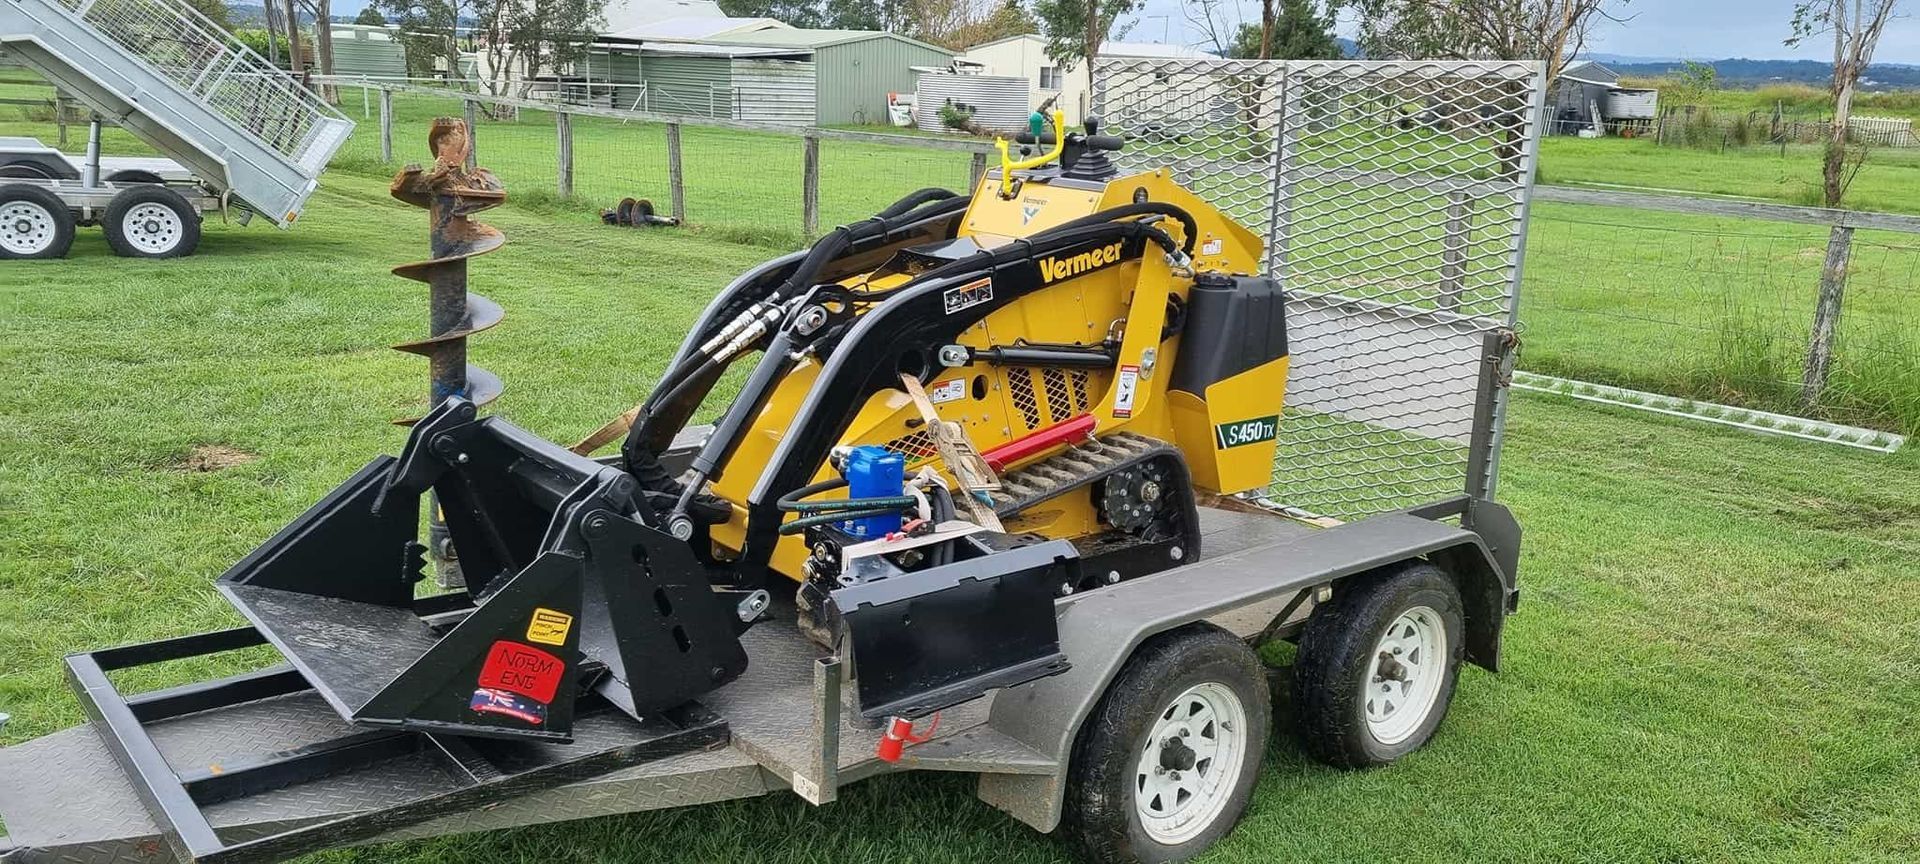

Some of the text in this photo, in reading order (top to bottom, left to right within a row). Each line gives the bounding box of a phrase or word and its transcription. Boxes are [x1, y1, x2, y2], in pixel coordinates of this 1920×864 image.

[1039, 242, 1122, 283] Vermeer
[499, 649, 554, 674] NORM
[500, 671, 536, 689] ENG
